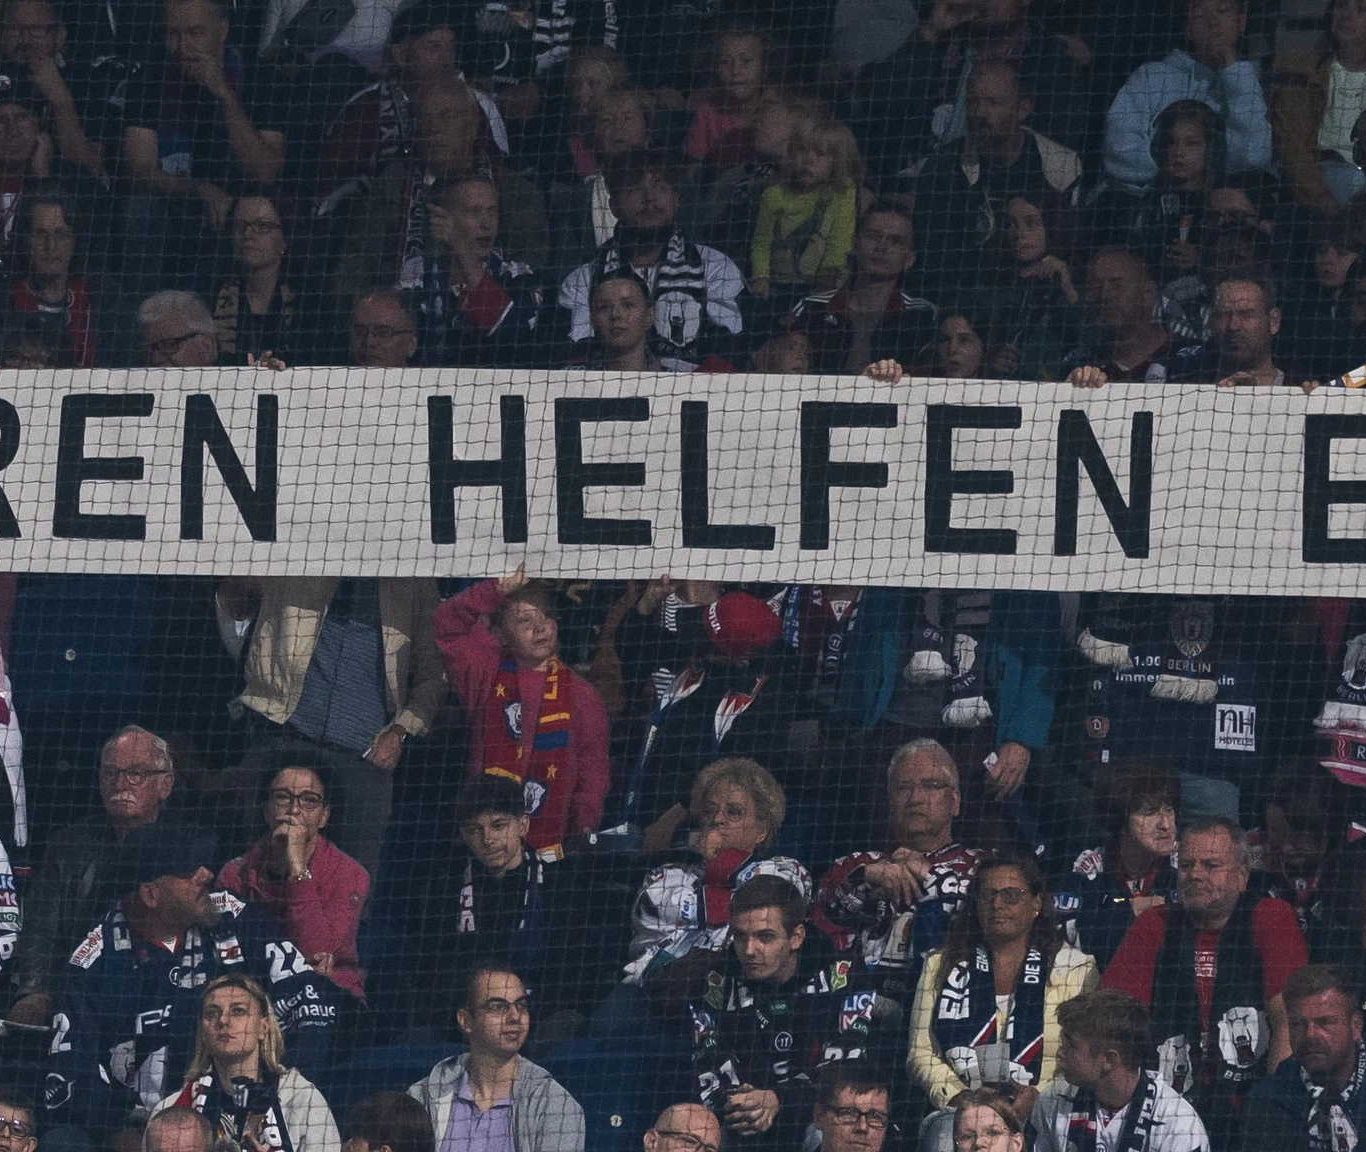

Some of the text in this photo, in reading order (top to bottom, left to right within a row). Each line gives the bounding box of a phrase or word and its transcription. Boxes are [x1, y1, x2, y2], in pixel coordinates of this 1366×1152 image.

[427, 394, 1154, 559] HELFEN
[1168, 658, 1212, 673] BERLIN
[265, 941, 315, 984] 22
